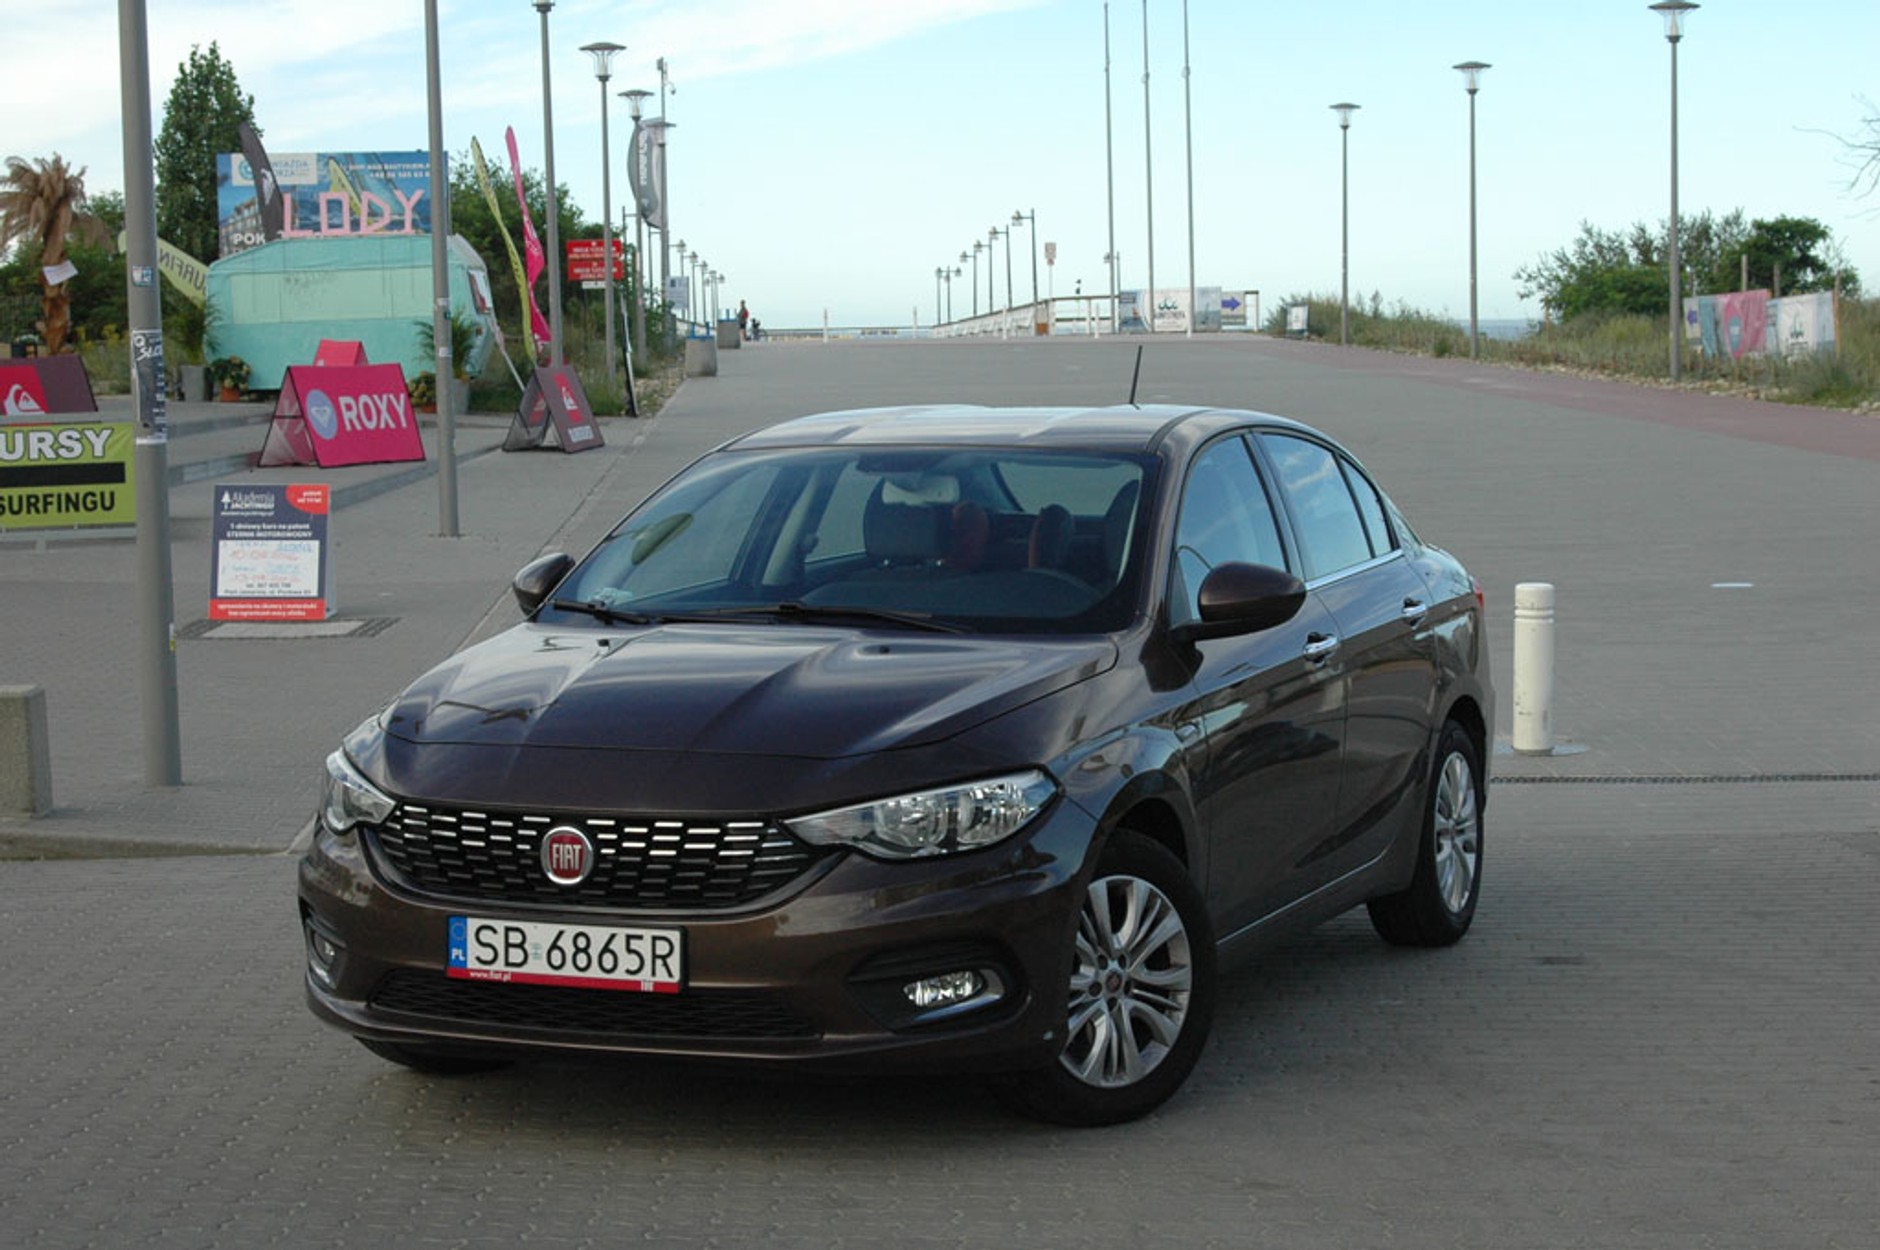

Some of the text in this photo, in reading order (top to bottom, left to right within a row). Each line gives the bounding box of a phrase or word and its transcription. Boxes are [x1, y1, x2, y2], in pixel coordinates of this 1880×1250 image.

[282, 189, 425, 238] LODY
[338, 393, 407, 432] ROXY
[552, 843, 582, 870] FIAT
[451, 948, 466, 962] PL
[474, 925, 675, 979] SB 6865R
